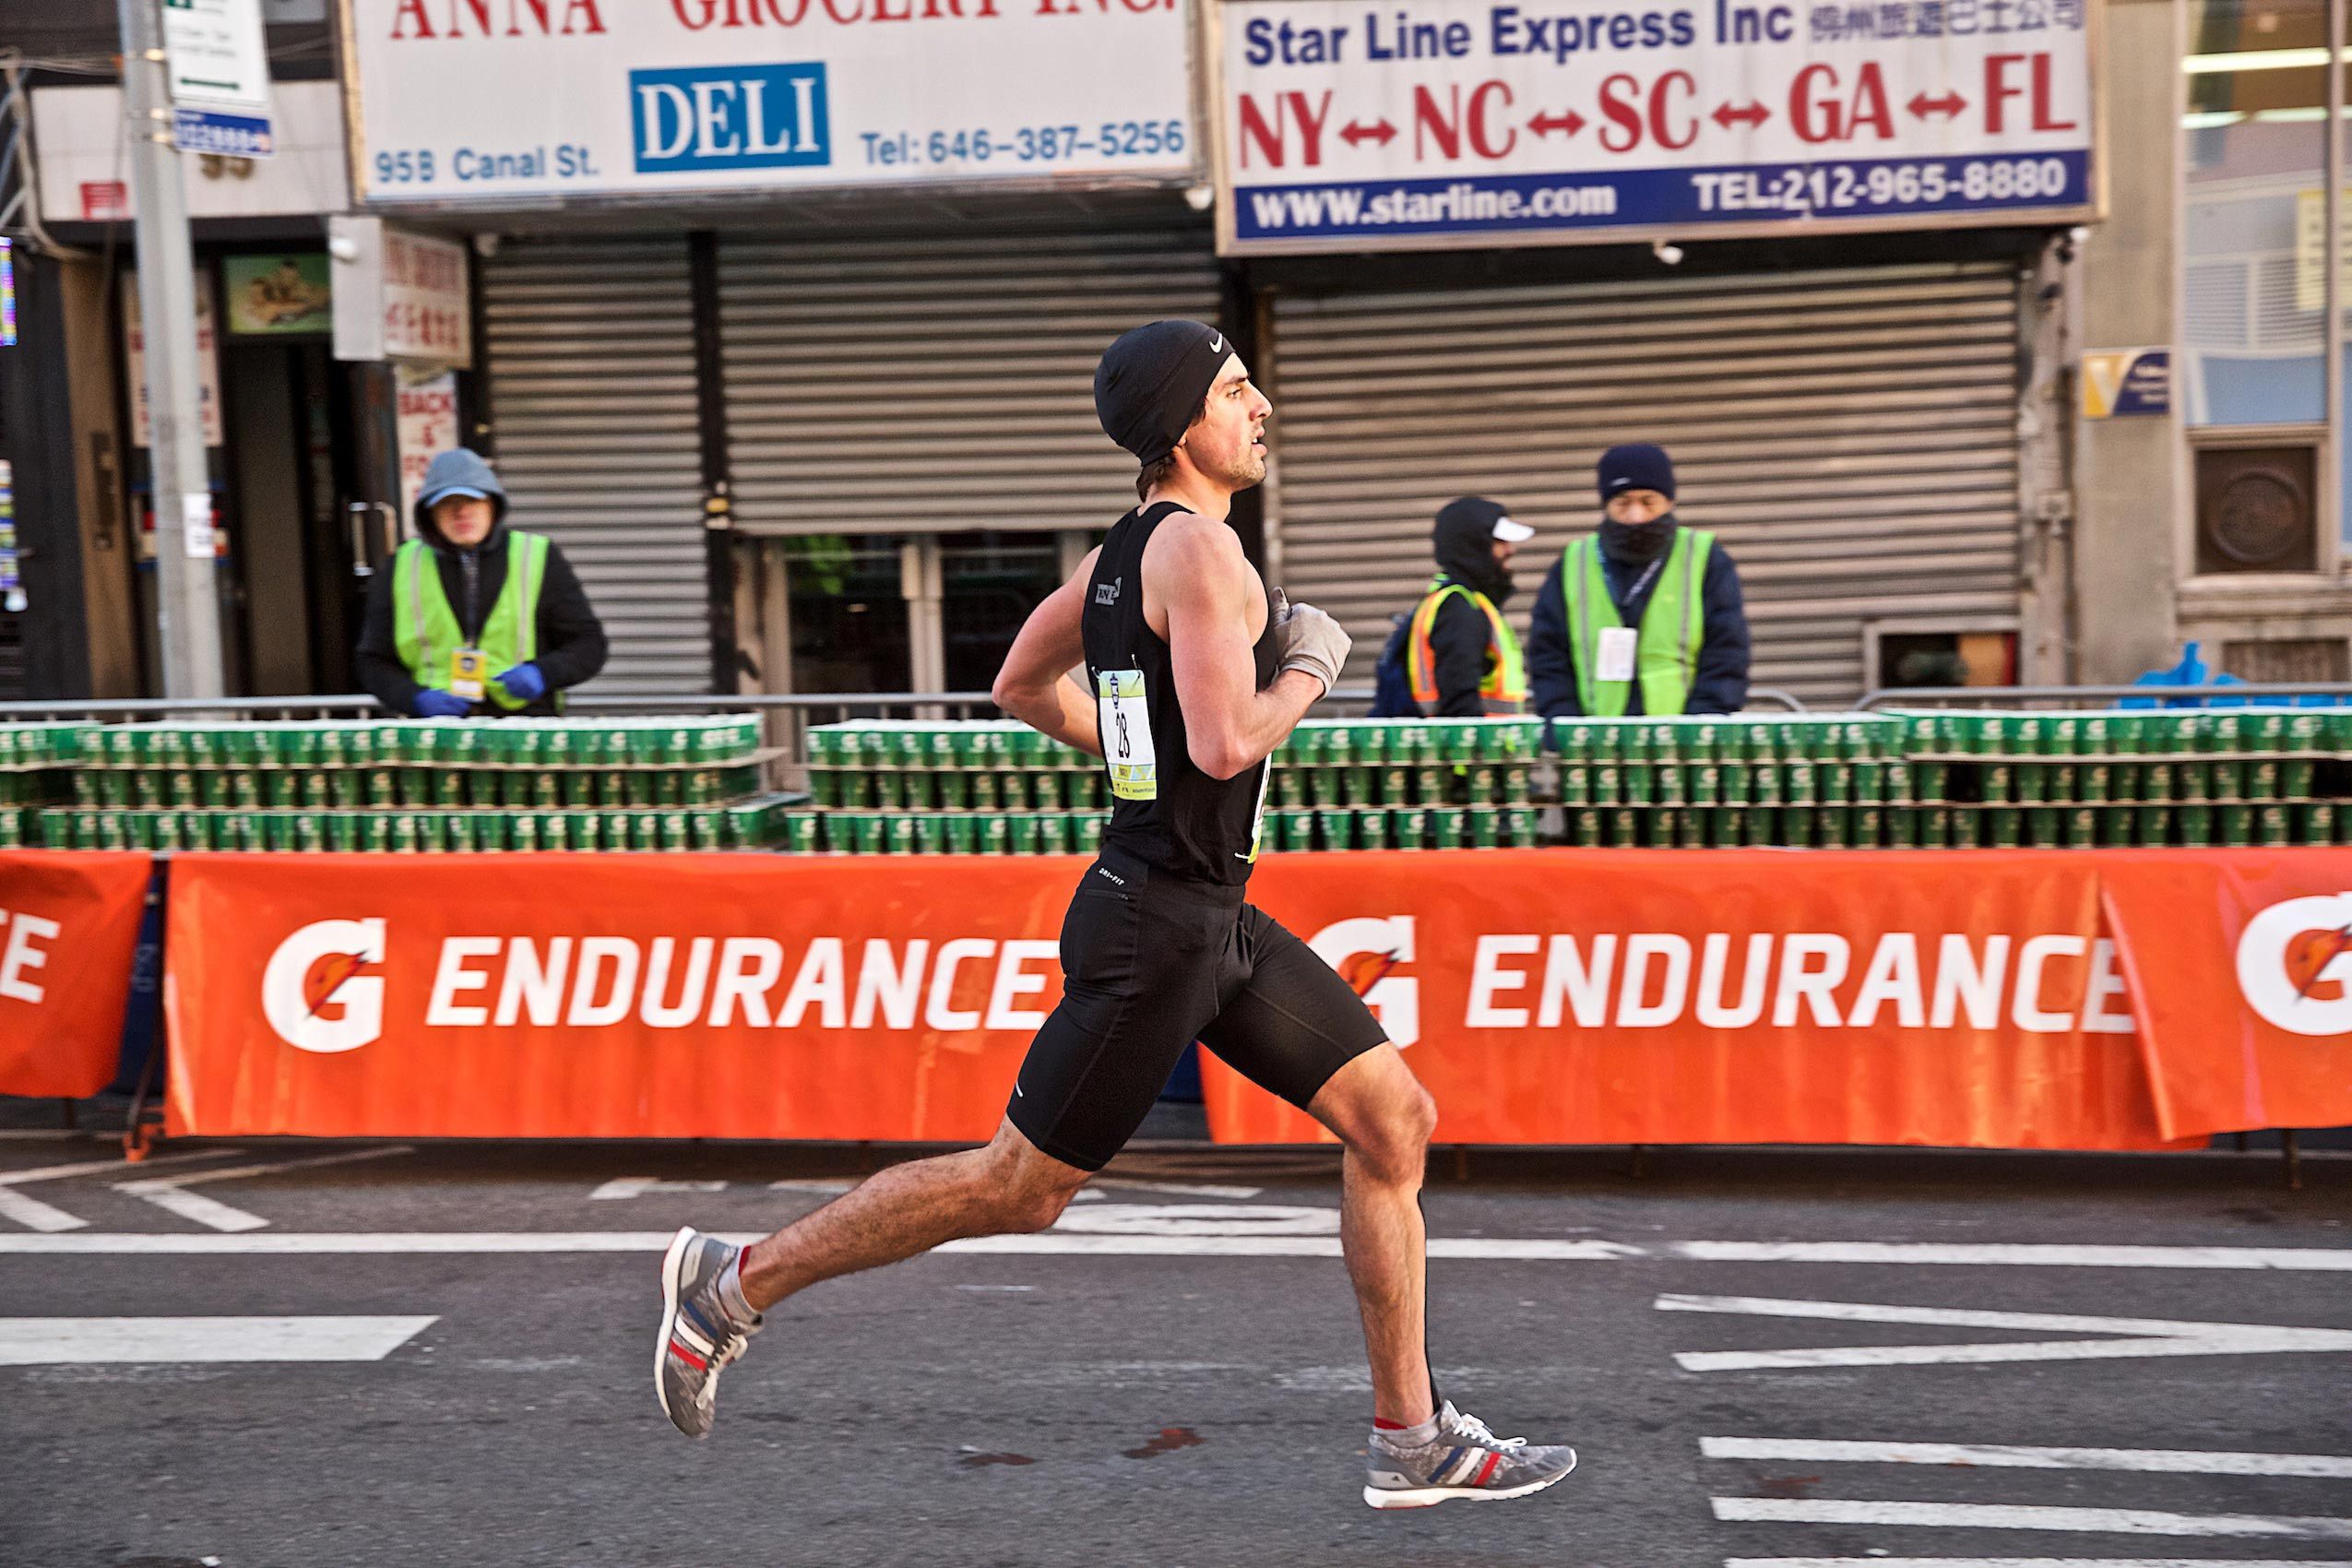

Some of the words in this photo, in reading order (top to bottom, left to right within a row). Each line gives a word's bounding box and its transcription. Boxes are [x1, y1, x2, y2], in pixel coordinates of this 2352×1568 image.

[1245, 17, 1349, 66] Star
[1365, 11, 1472, 61] Line
[1491, 6, 1695, 65] Express
[1716, 0, 1794, 43] Inc
[637, 77, 820, 160] DELI
[1239, 89, 1333, 170] NY
[1414, 78, 1517, 162] NC
[1598, 69, 1700, 154] SC
[1788, 61, 1895, 145] GA
[1983, 52, 2077, 135] FL
[374, 149, 434, 183] 95B
[453, 146, 546, 180] Canal
[555, 144, 599, 177] St.
[1116, 712, 1130, 758] 28
[0, 908, 61, 1004] E
[261, 916, 388, 1053] G
[425, 936, 1060, 1031] ENDURANCE
[1465, 932, 2136, 1034] ENDURANCE
